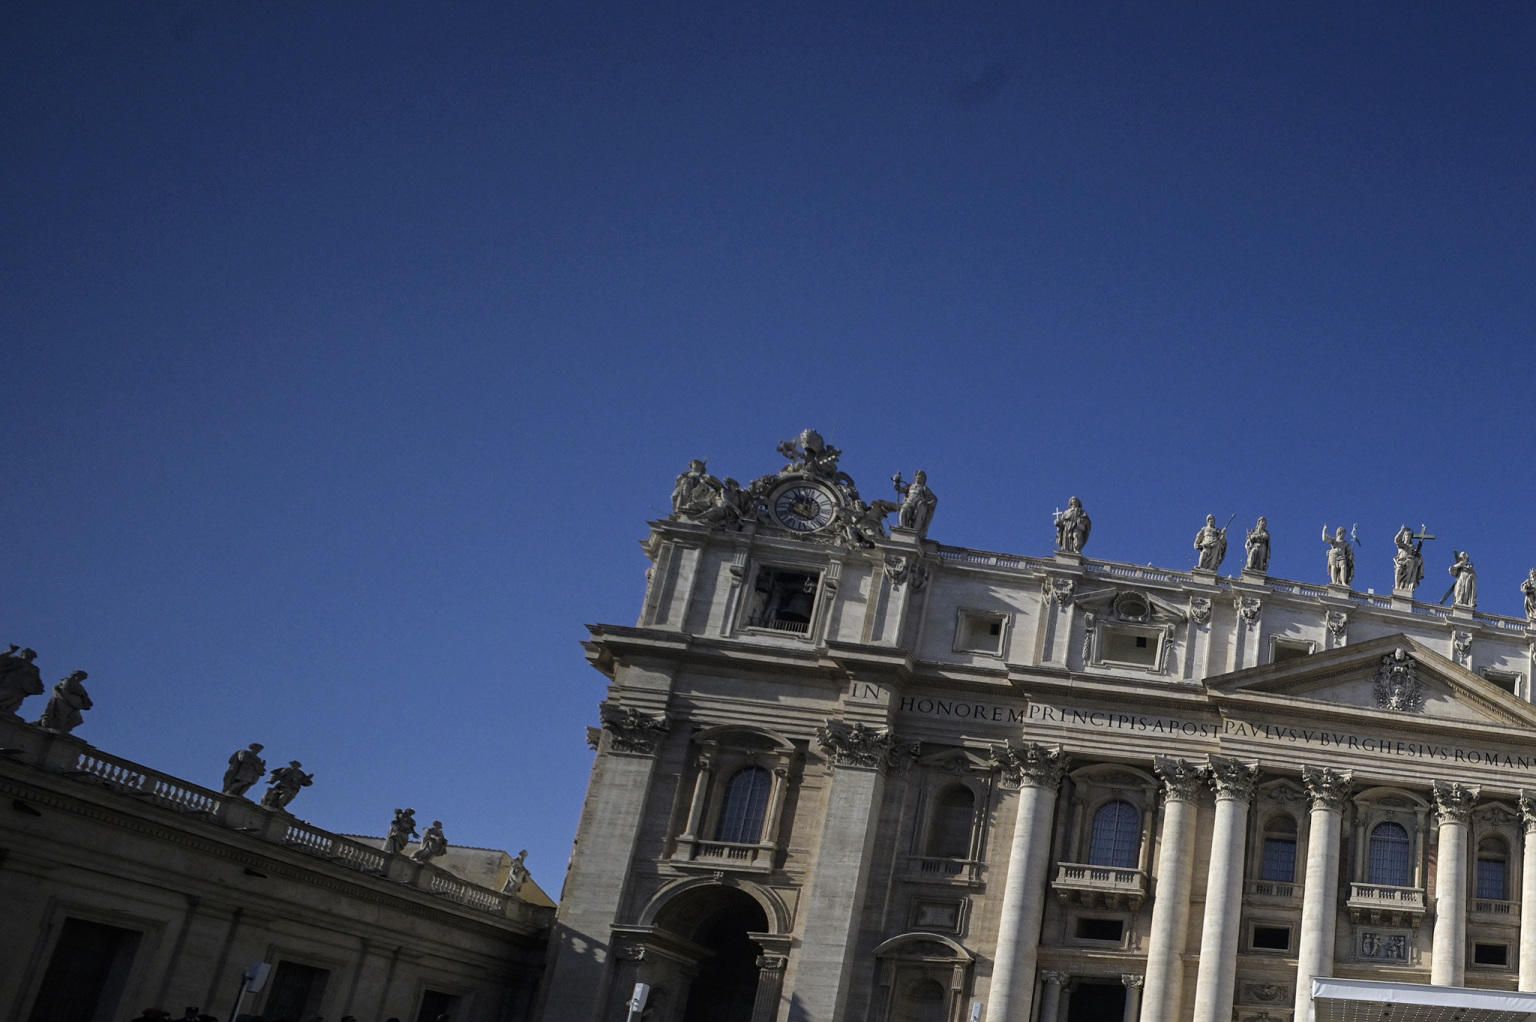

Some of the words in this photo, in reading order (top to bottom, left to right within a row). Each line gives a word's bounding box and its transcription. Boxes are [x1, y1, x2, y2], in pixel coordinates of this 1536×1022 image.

[852, 683, 881, 699] IN
[900, 697, 1024, 724] HONOREM
[1029, 704, 1148, 731] PRINCIPIS
[1152, 719, 1223, 738] APOST
[1224, 720, 1297, 741] PAVLVS
[1320, 732, 1448, 761] BVRGHESIVS
